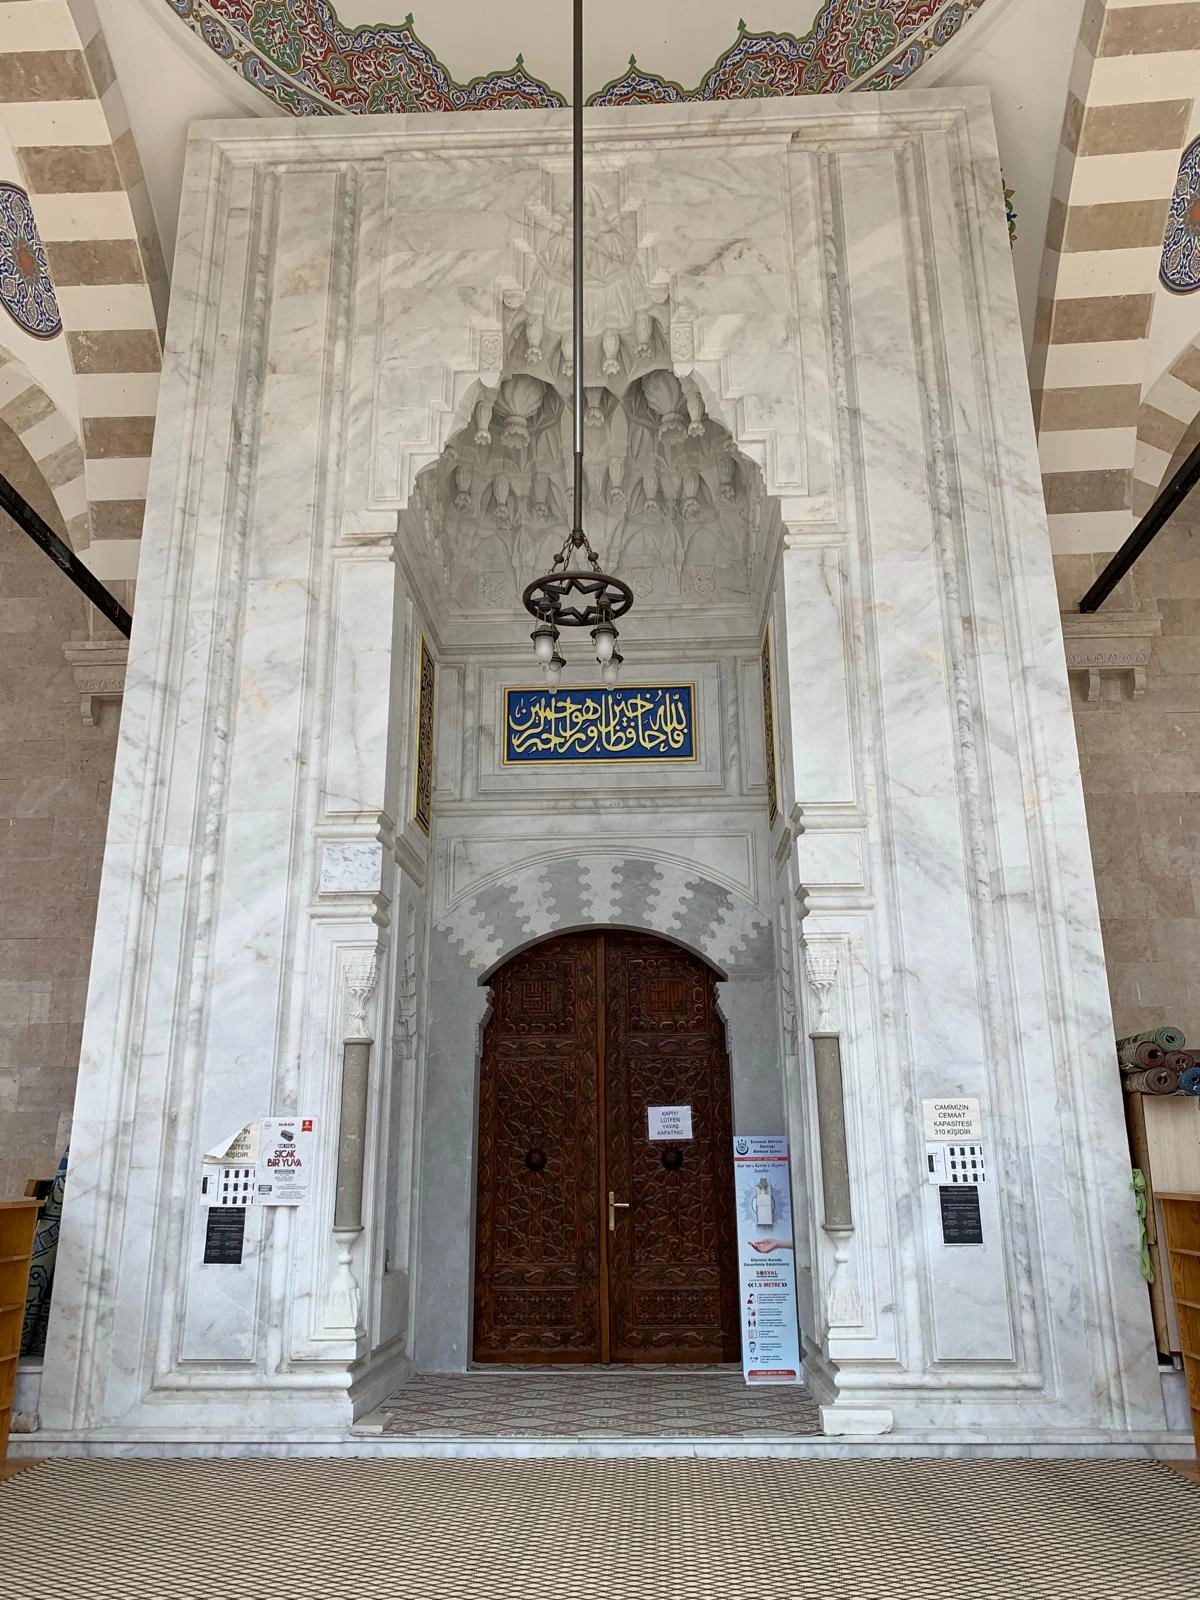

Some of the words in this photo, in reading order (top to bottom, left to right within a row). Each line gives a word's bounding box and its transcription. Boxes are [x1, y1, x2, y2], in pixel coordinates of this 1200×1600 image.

[934, 1103, 969, 1111] CAMİMİZİN
[274, 1149, 296, 1158] SICAK
[282, 1158, 302, 1167] YUVA
